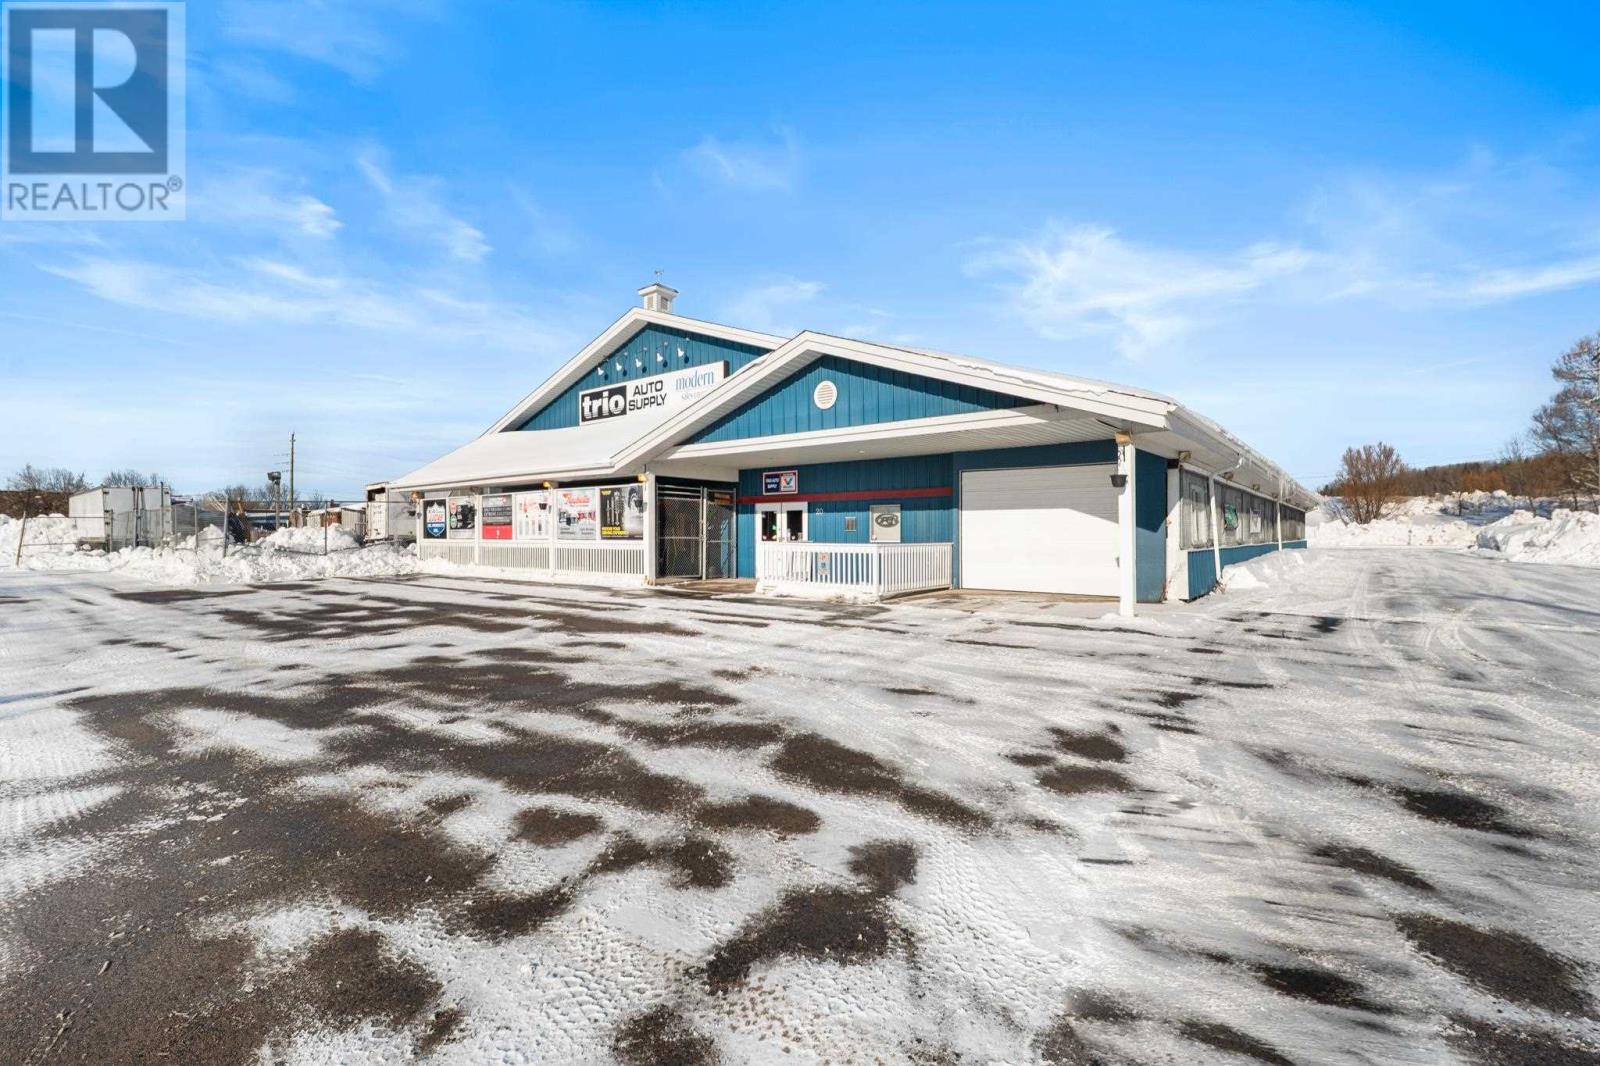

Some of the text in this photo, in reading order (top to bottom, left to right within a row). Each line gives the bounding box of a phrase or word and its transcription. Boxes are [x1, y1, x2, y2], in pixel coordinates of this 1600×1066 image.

[633, 380, 663, 397] AUTO
[675, 370, 714, 391] modern
[582, 391, 626, 420] trio
[628, 393, 667, 411] SUPPLY
